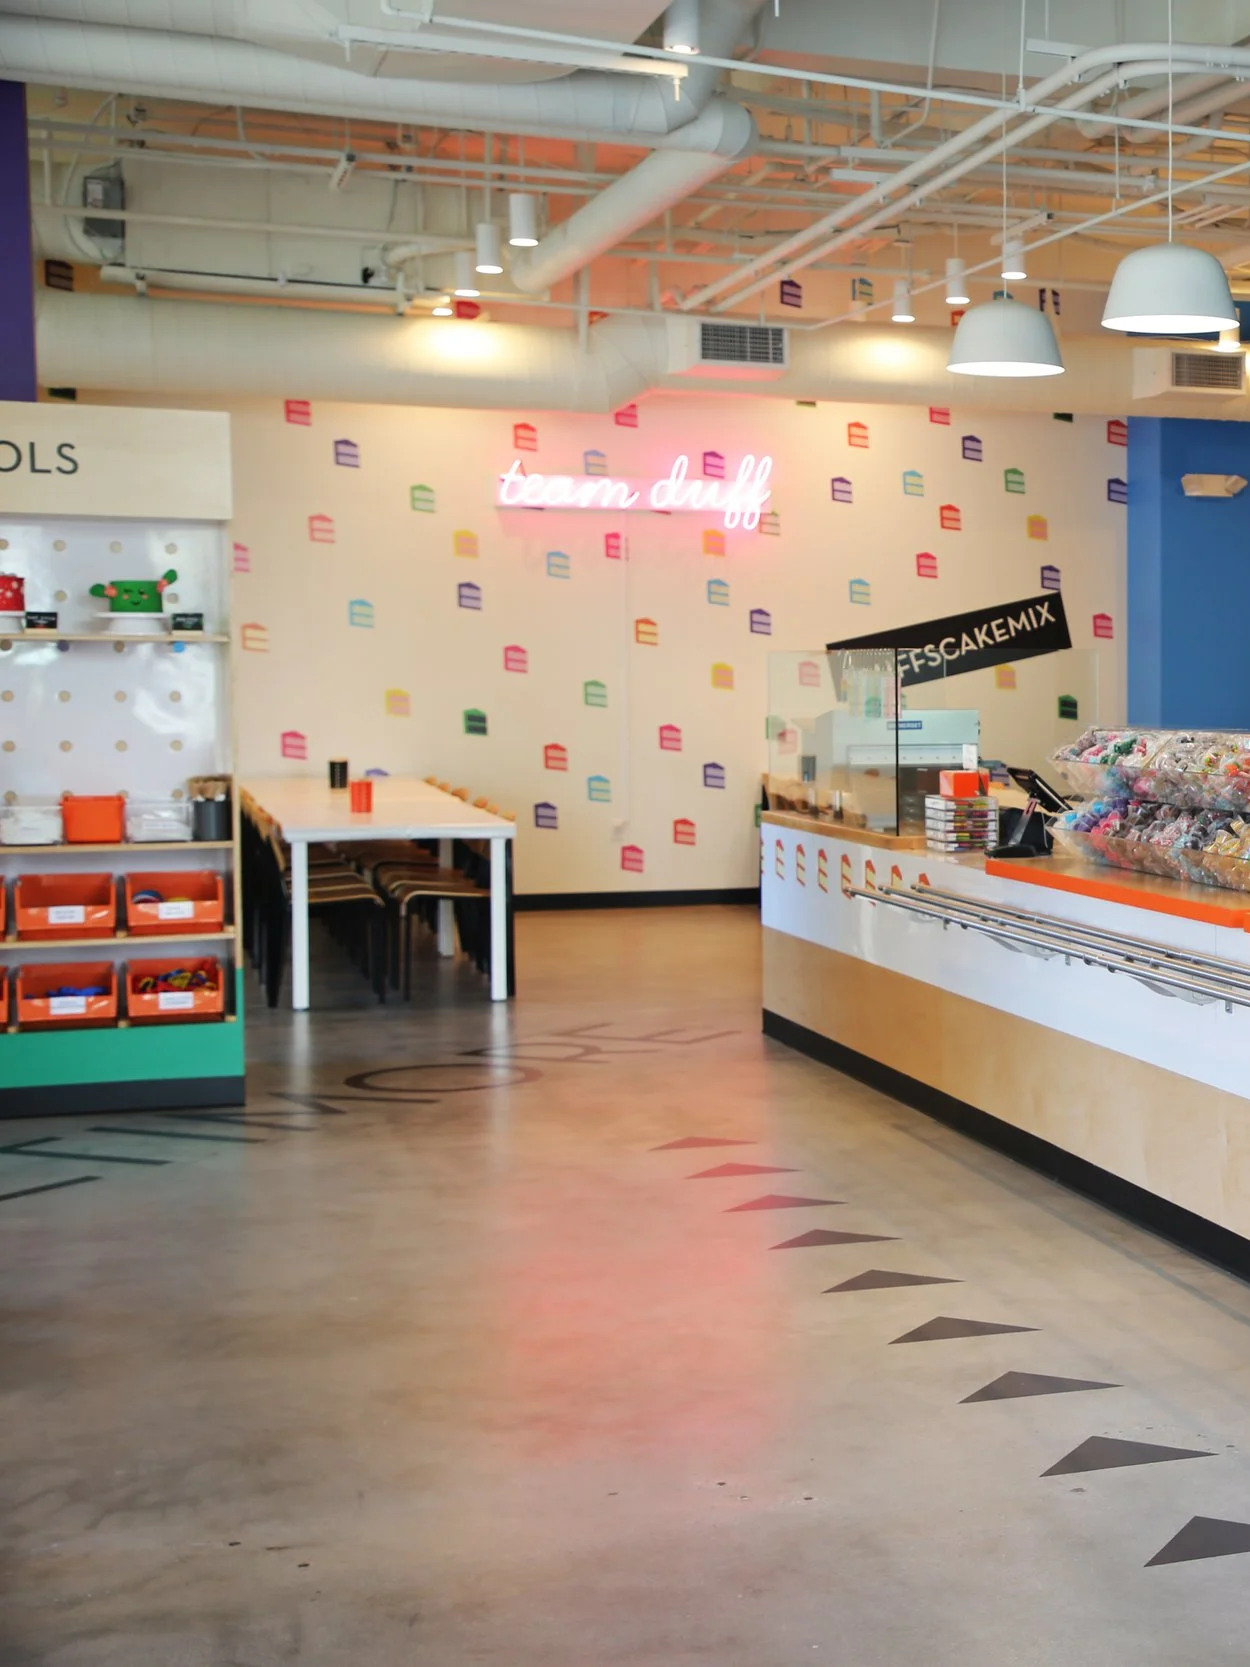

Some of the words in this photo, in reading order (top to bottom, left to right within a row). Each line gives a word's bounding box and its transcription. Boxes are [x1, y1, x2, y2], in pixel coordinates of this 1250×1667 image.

[499, 459, 640, 508] team
[650, 454, 773, 530] duff
[896, 601, 1056, 679] FFSCAKEMIX
